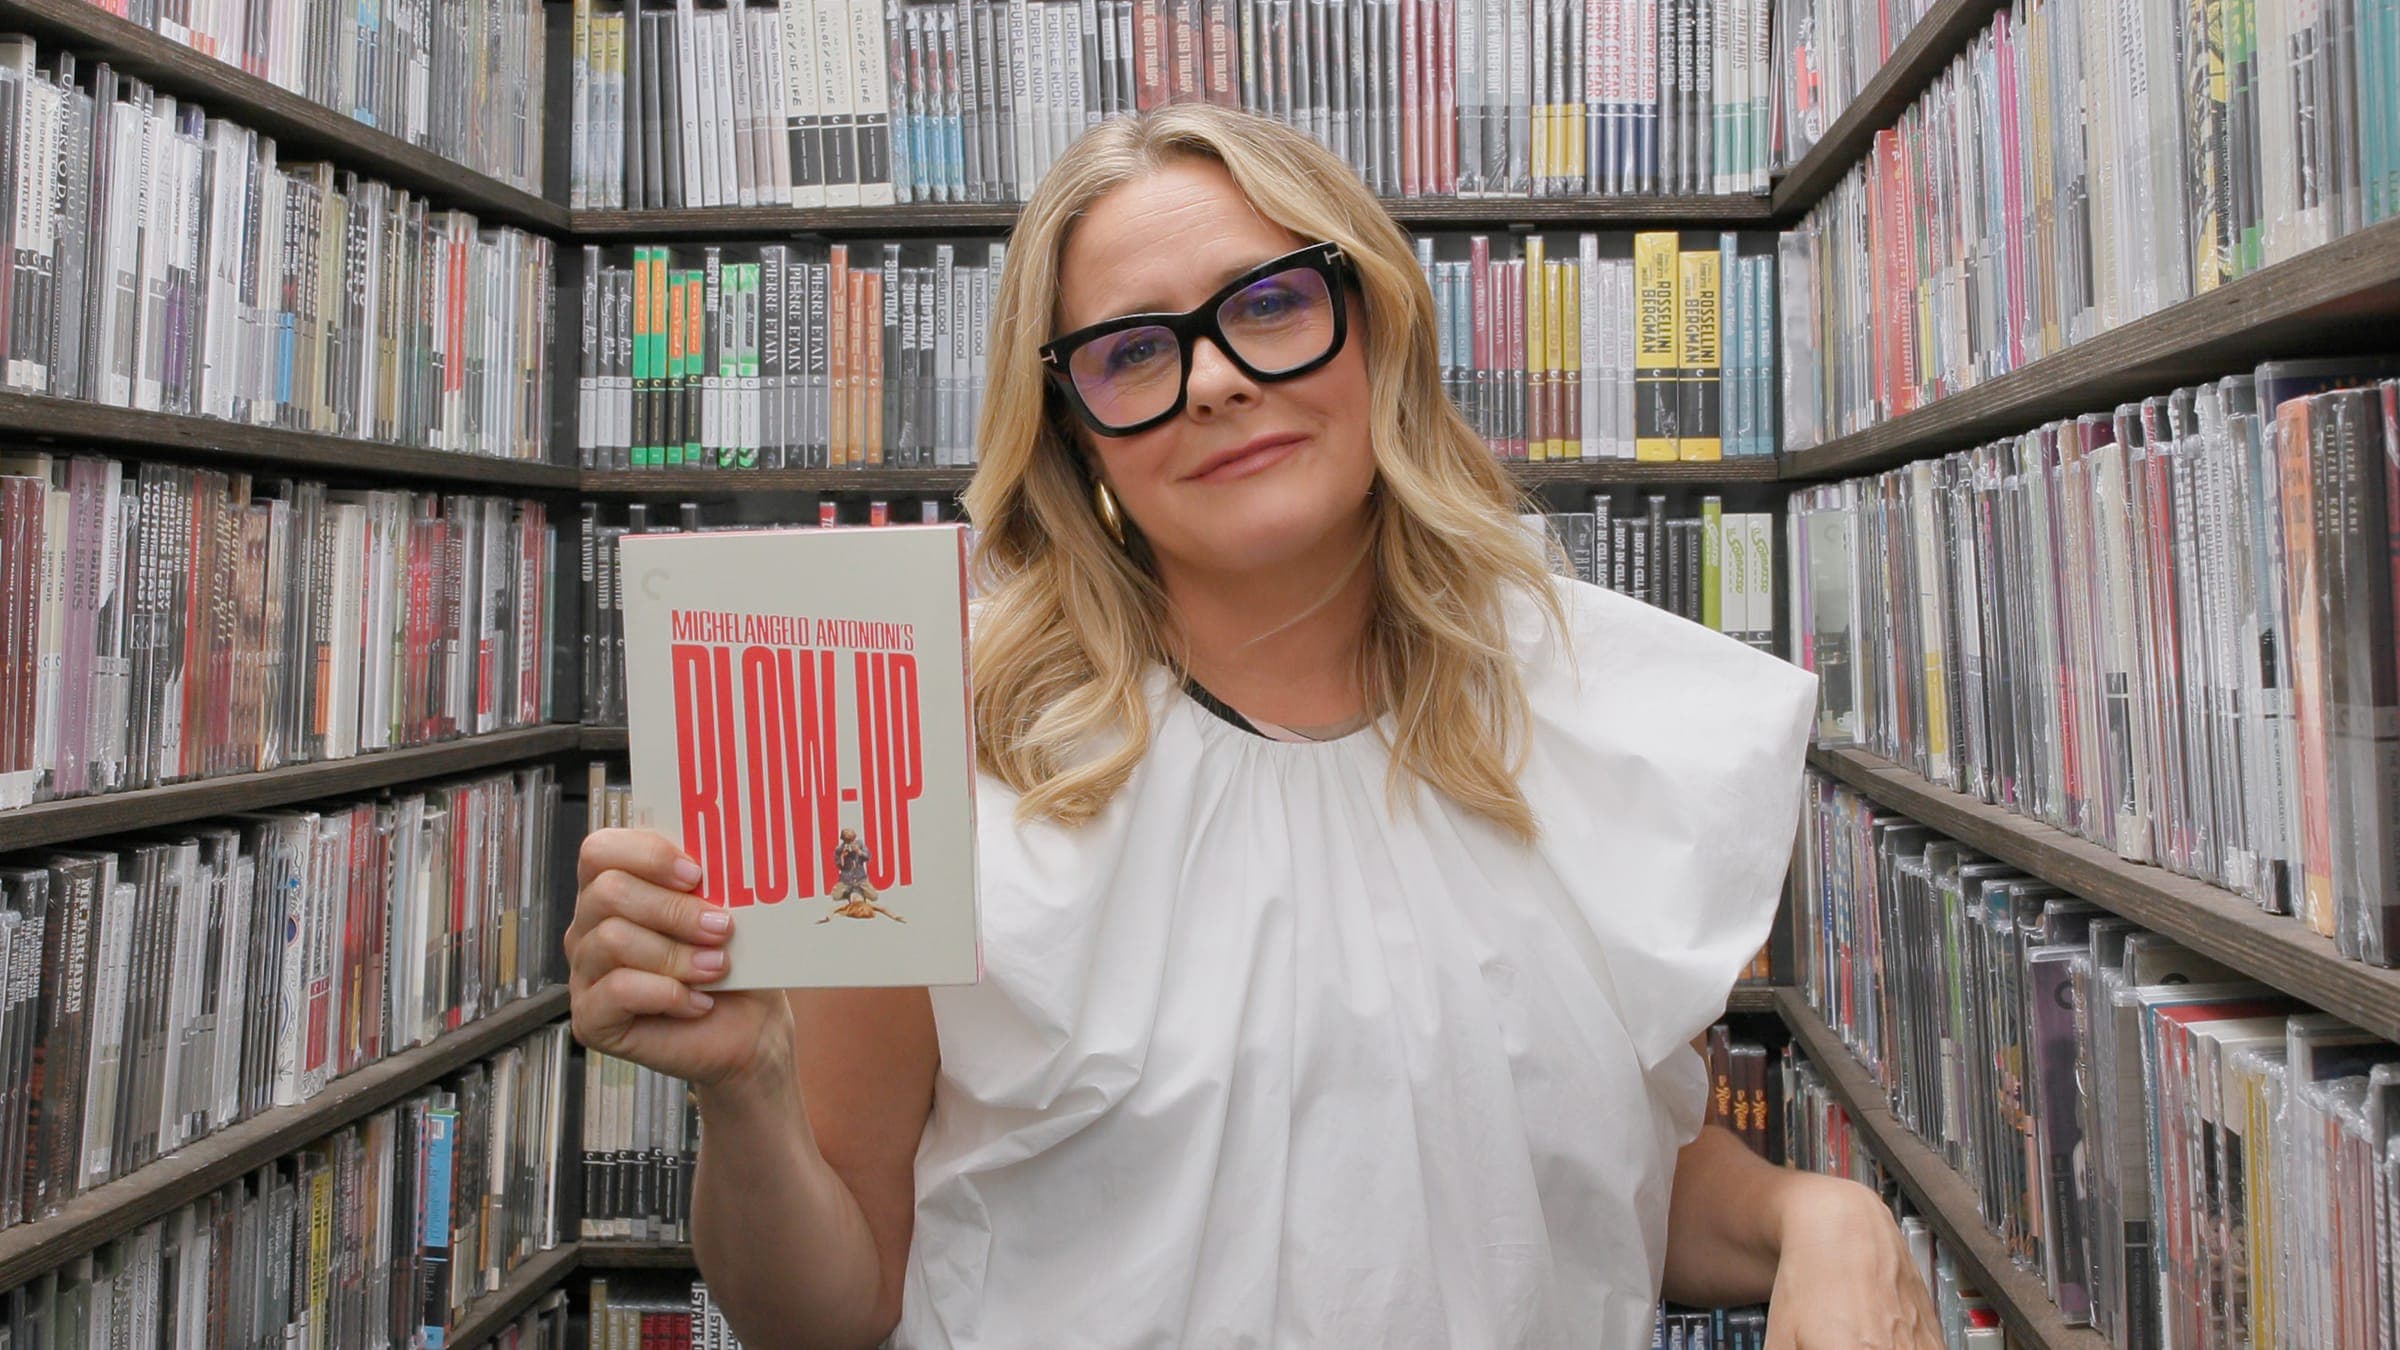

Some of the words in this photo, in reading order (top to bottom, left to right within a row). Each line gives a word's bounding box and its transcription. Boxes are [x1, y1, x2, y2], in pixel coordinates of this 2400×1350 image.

[1011, 2, 1023, 55] PURPLE
[1142, 0, 1155, 17] THE
[1176, 5, 1191, 23] THE
[1210, 4, 1225, 23] THE
[1487, 14, 1502, 32] THE
[1511, 15, 1525, 32] THE
[1678, 8, 1692, 16] A
[1696, 8, 1710, 16] A
[818, 10, 830, 57] TRILOGY
[854, 8, 866, 57] TRILOGY
[1030, 8, 1042, 62] PURPLE
[1047, 13, 1060, 65] PURPLE
[1066, 13, 1079, 65] PURPLE
[1143, 18, 1156, 46] QATSI
[1177, 24, 1192, 52] QATSI
[1211, 24, 1226, 52] QATSI
[1678, 18, 1692, 41] MAN
[1696, 18, 1710, 41] MAN
[26, 60, 34, 84] THE
[790, 55, 800, 72] OF
[823, 61, 833, 74] OF
[859, 60, 868, 74] OF
[1144, 48, 1158, 87] TRILOGY
[1487, 32, 1502, 94] WATERFRONT
[1511, 32, 1525, 96] WATERFRONT
[1587, 45, 1602, 59] OF
[1605, 46, 1620, 60] OF
[1661, 37, 1676, 86] ESCAPED
[1678, 45, 1693, 92] ESCAPED
[1696, 45, 1710, 92] ESCAPED
[792, 77, 802, 106] LIFE
[826, 79, 835, 104] LIFE
[860, 78, 870, 104] LIFE
[1014, 60, 1025, 97] NOON
[1033, 67, 1044, 104] NOON
[1051, 71, 1062, 108] NOON
[1069, 71, 1080, 108] NOON
[1179, 53, 1193, 92] TRILOGY
[1212, 53, 1228, 92] TRILOGY
[1587, 64, 1602, 97] FEAR
[1605, 64, 1620, 98] FEAR
[39, 97, 47, 117] THE
[58, 73, 72, 178] UMBERTO
[22, 90, 33, 169] HONEYMOON
[36, 122, 46, 188] HONEYMOON
[20, 175, 30, 230] KILLERS
[34, 193, 43, 234] KILLERS
[46, 196, 56, 240] KILLERS
[707, 257, 719, 284] REPO
[765, 260, 778, 313] PIERRE
[938, 256, 949, 306] medium
[788, 267, 802, 321] PIERRE
[811, 267, 825, 321] PIERRE
[884, 292, 898, 327] YUMA
[956, 281, 967, 331] medium
[974, 278, 986, 328] medium
[902, 315, 916, 350] YUMA
[920, 315, 934, 350] YUMA
[938, 309, 949, 336] cool
[1641, 289, 1656, 354] BERGMAN
[1656, 281, 1672, 354] ROSSELLINI
[1684, 298, 1700, 363] BERGMAN
[1699, 290, 1715, 363] ROSSELLINI
[1726, 308, 1735, 336] Witch
[765, 318, 778, 365] ETAIX
[788, 325, 802, 370] ETAIX
[811, 325, 825, 370] ETAIX
[956, 334, 968, 360] cool
[974, 330, 986, 357] cool
[1743, 330, 1752, 358] Witch
[1760, 330, 1770, 358] Witch
[2326, 423, 2337, 483] CITIZEN
[2344, 421, 2356, 482] CITIZEN
[141, 480, 151, 538] YOUTH
[150, 482, 160, 538] YOUTH
[160, 480, 170, 554] FIGHTING
[168, 482, 176, 556] FIGHTING
[176, 496, 184, 542] CASQUE
[184, 496, 192, 542] CASQUE
[216, 489, 226, 545] NIGHT
[582, 517, 593, 535] THE
[1597, 506, 1608, 528] RIOT
[2329, 497, 2340, 536] KANE
[2348, 496, 2358, 536] KANE
[221, 520, 232, 573] NIGHT
[230, 517, 240, 572] NIGHT
[1597, 530, 1608, 541] IN
[1615, 528, 1626, 550] RIOT
[1634, 532, 1645, 554] RIOT
[2213, 489, 2224, 570] INCREDIBLE
[598, 546, 609, 563] THE
[1597, 542, 1608, 562] CELL
[1615, 551, 1626, 562] IN
[1634, 556, 1645, 566] IN
[1727, 535, 1745, 594] Sorpasso
[1752, 534, 1770, 594] Sorpasso
[138, 554, 148, 611] BEAST
[146, 555, 157, 610] BEAST
[157, 562, 166, 609] ELEGY
[164, 559, 173, 610] ELEGY
[213, 572, 223, 614] CITY
[1615, 564, 1626, 584] CELL
[1634, 568, 1645, 588] CELL
[218, 602, 228, 645] CITY
[226, 600, 236, 640] CITY
[671, 609, 811, 647] MICHELANGELO
[815, 621, 914, 651] ANTONIONI'S
[671, 643, 923, 909] BLOW-UP
[2274, 746, 2282, 787] CRITERION
[2277, 790, 2286, 842] COLLECTION
[60, 908, 68, 962] ARKADIN
[69, 908, 78, 976] CONFIDENTIAL
[72, 918, 87, 1013] ARKADIN
[1715, 1087, 1731, 1116] Rose
[1734, 1101, 1748, 1130] Rose
[1752, 1101, 1767, 1130] Rose
[2058, 1180, 2066, 1194] THE
[690, 1291, 706, 1341] STATE
